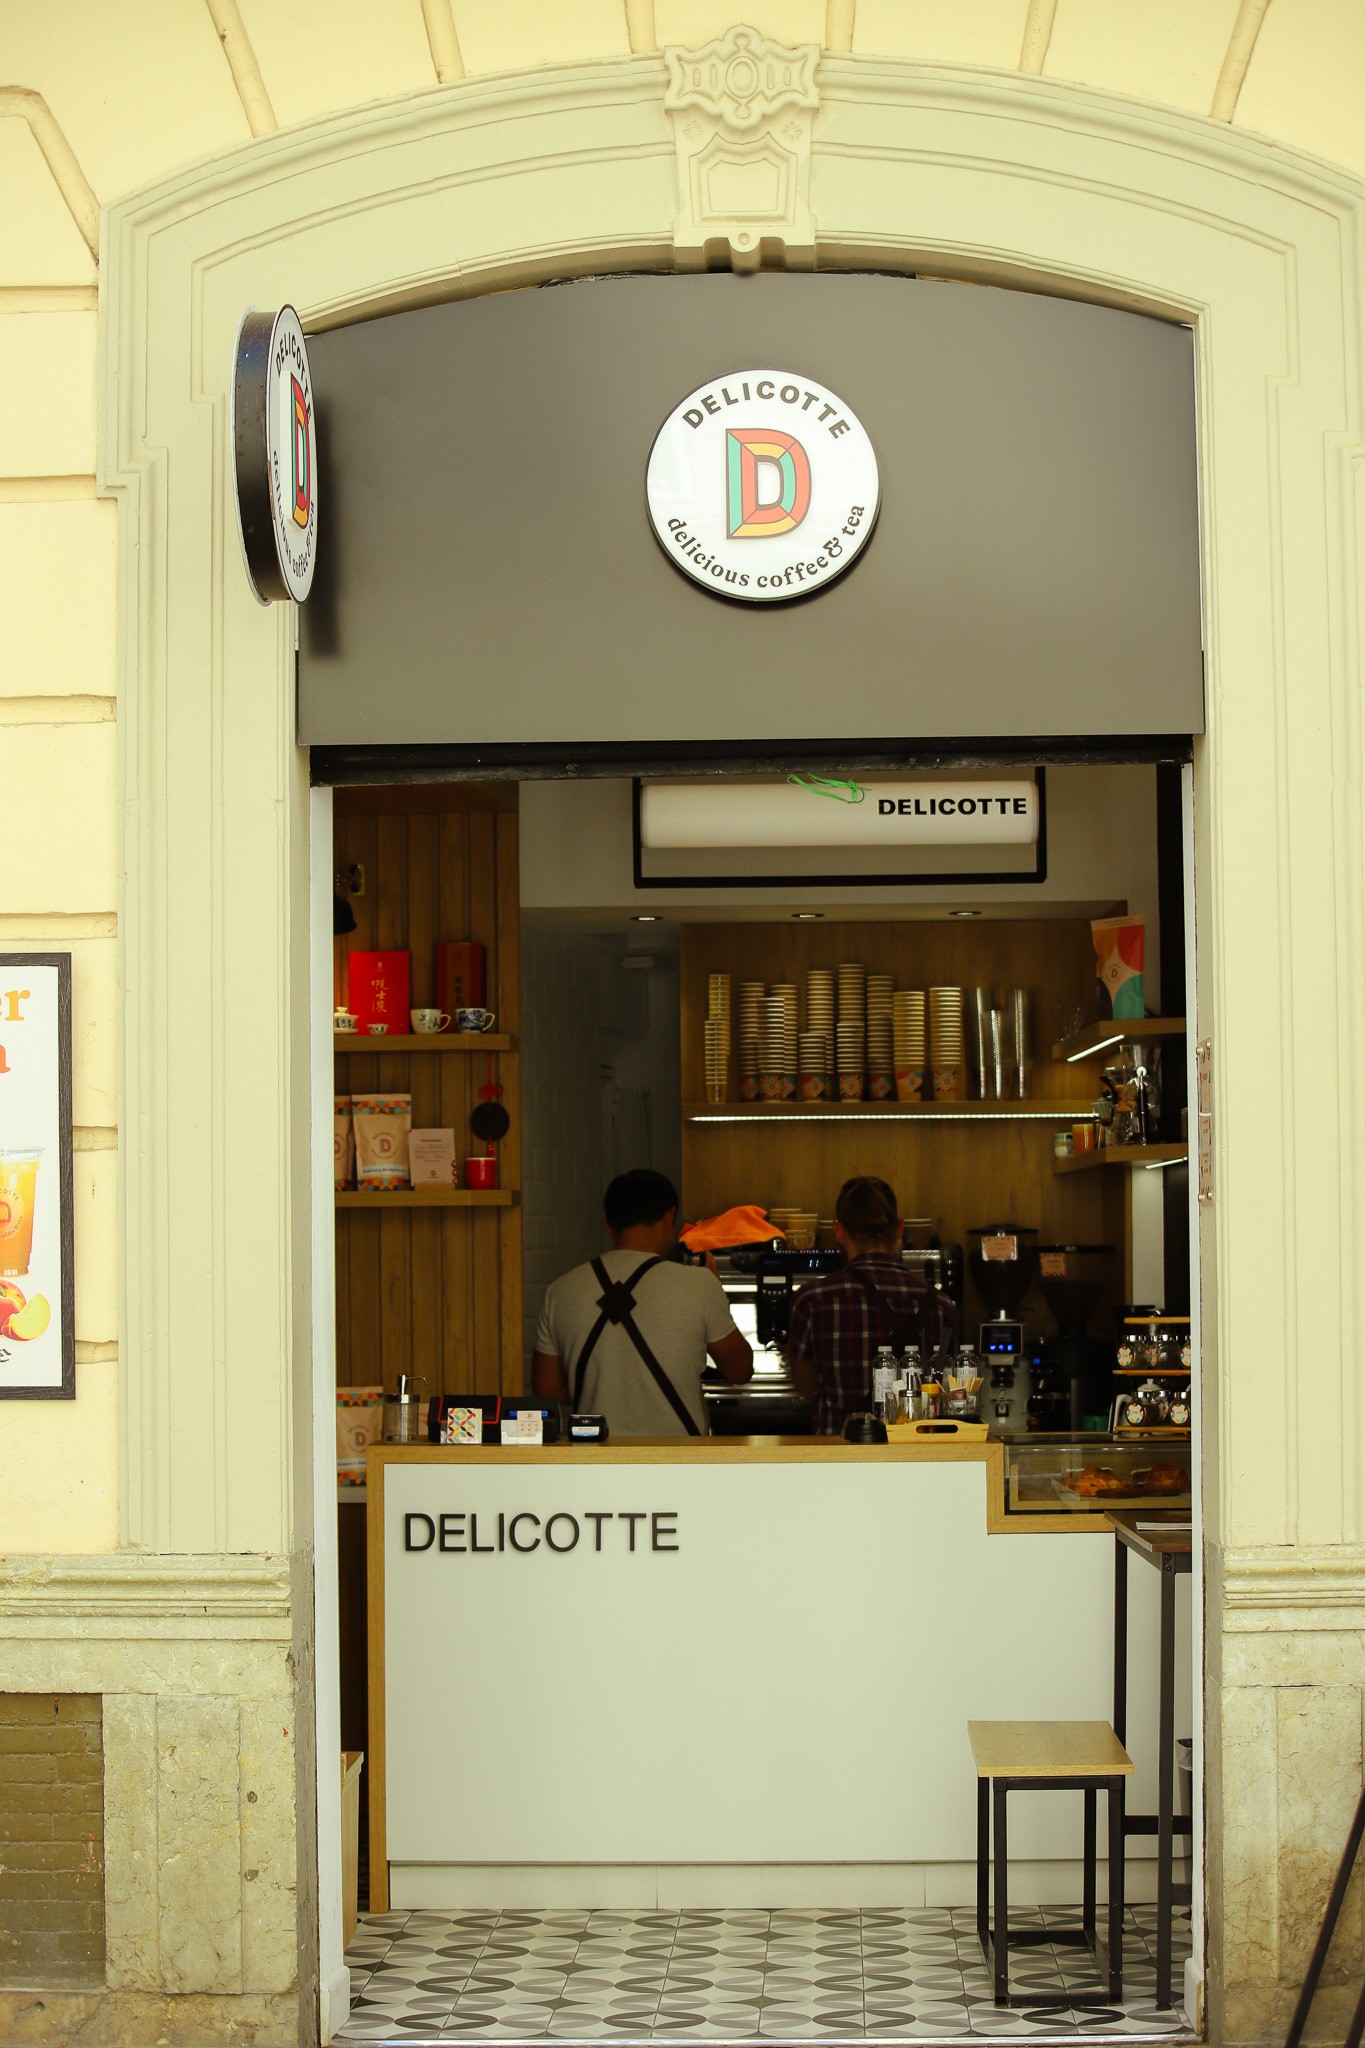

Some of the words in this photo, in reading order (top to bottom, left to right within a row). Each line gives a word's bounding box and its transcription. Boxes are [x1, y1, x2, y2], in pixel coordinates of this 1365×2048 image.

[276, 332, 311, 424] DELICOTTE
[682, 380, 851, 439] DELICOTTE
[726, 428, 812, 539] D
[667, 517, 751, 587] delicious
[756, 556, 829, 588] coffee
[822, 537, 843, 559] &
[841, 505, 865, 537] tea
[878, 797, 1028, 816] DELICOTTE
[405, 1512, 680, 1552] DELICOTTE
